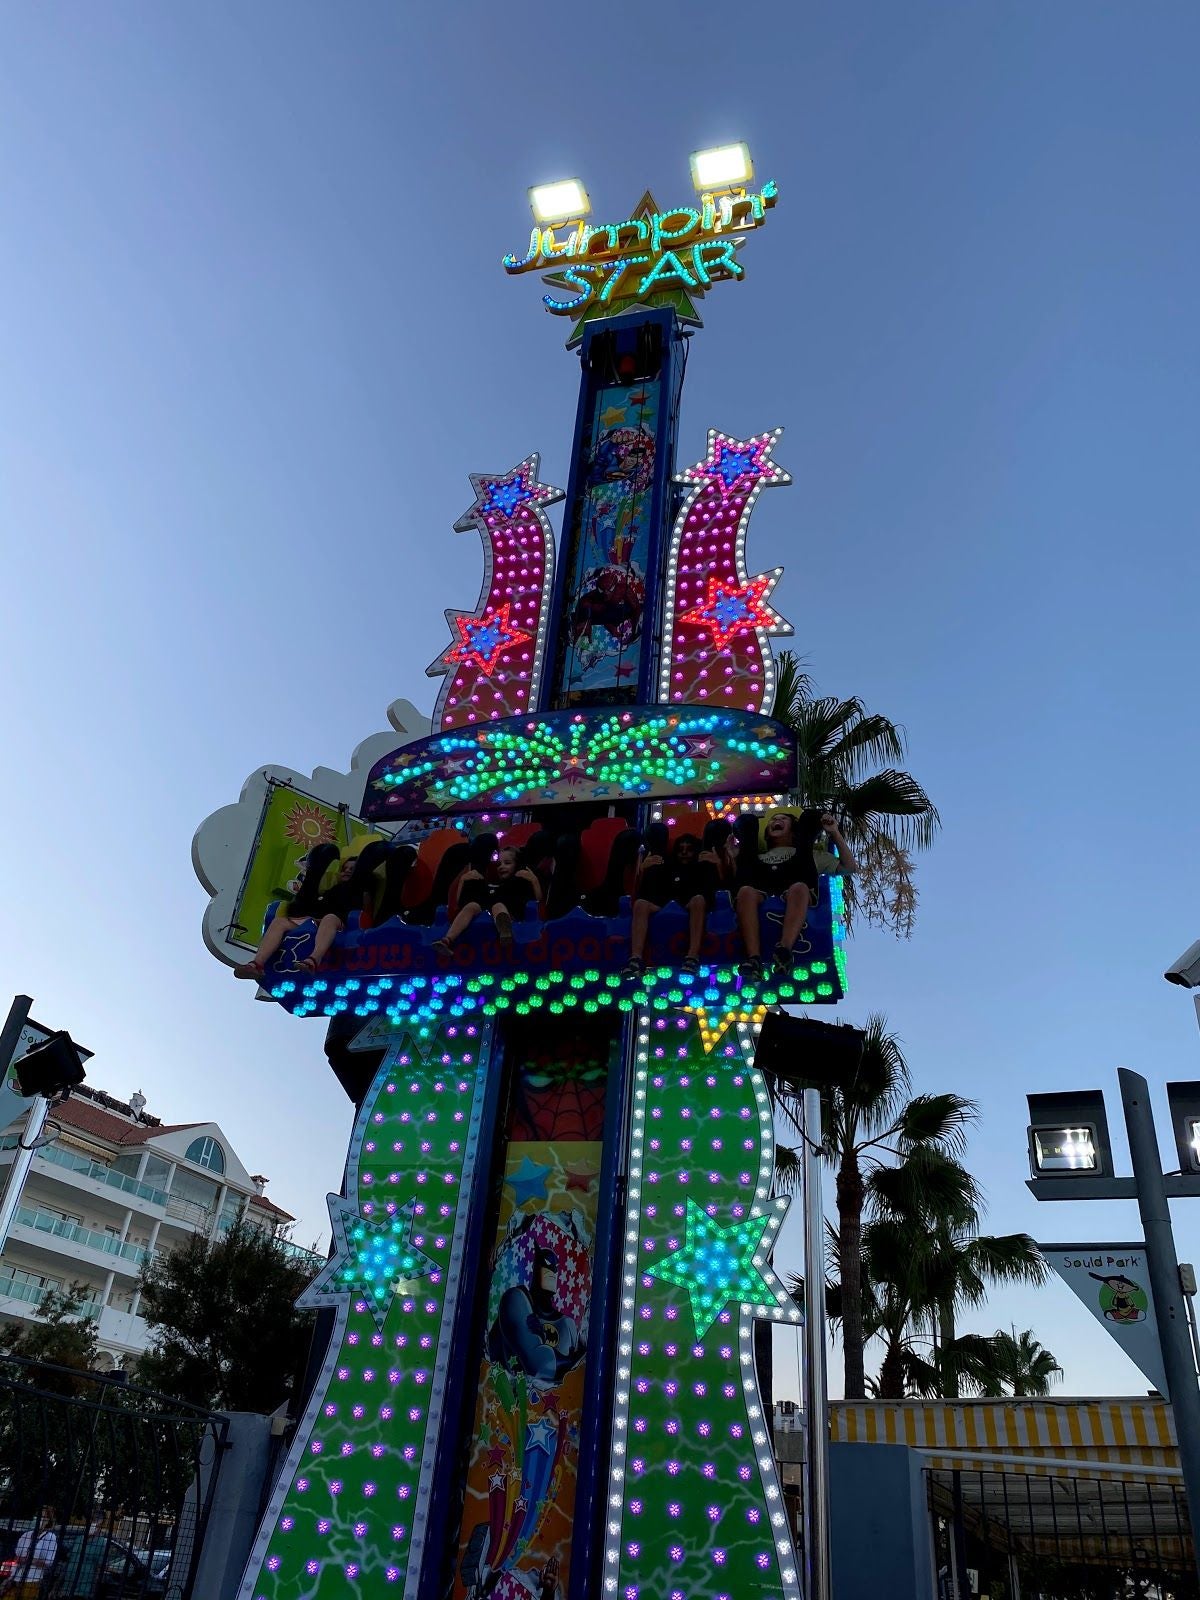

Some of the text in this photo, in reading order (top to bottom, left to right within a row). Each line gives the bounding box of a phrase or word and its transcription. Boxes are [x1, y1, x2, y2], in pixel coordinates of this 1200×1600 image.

[542, 240, 744, 312] STAR
[315, 929, 748, 971] www.ouldpar.co
[1063, 1255, 1138, 1268] Sould Park
